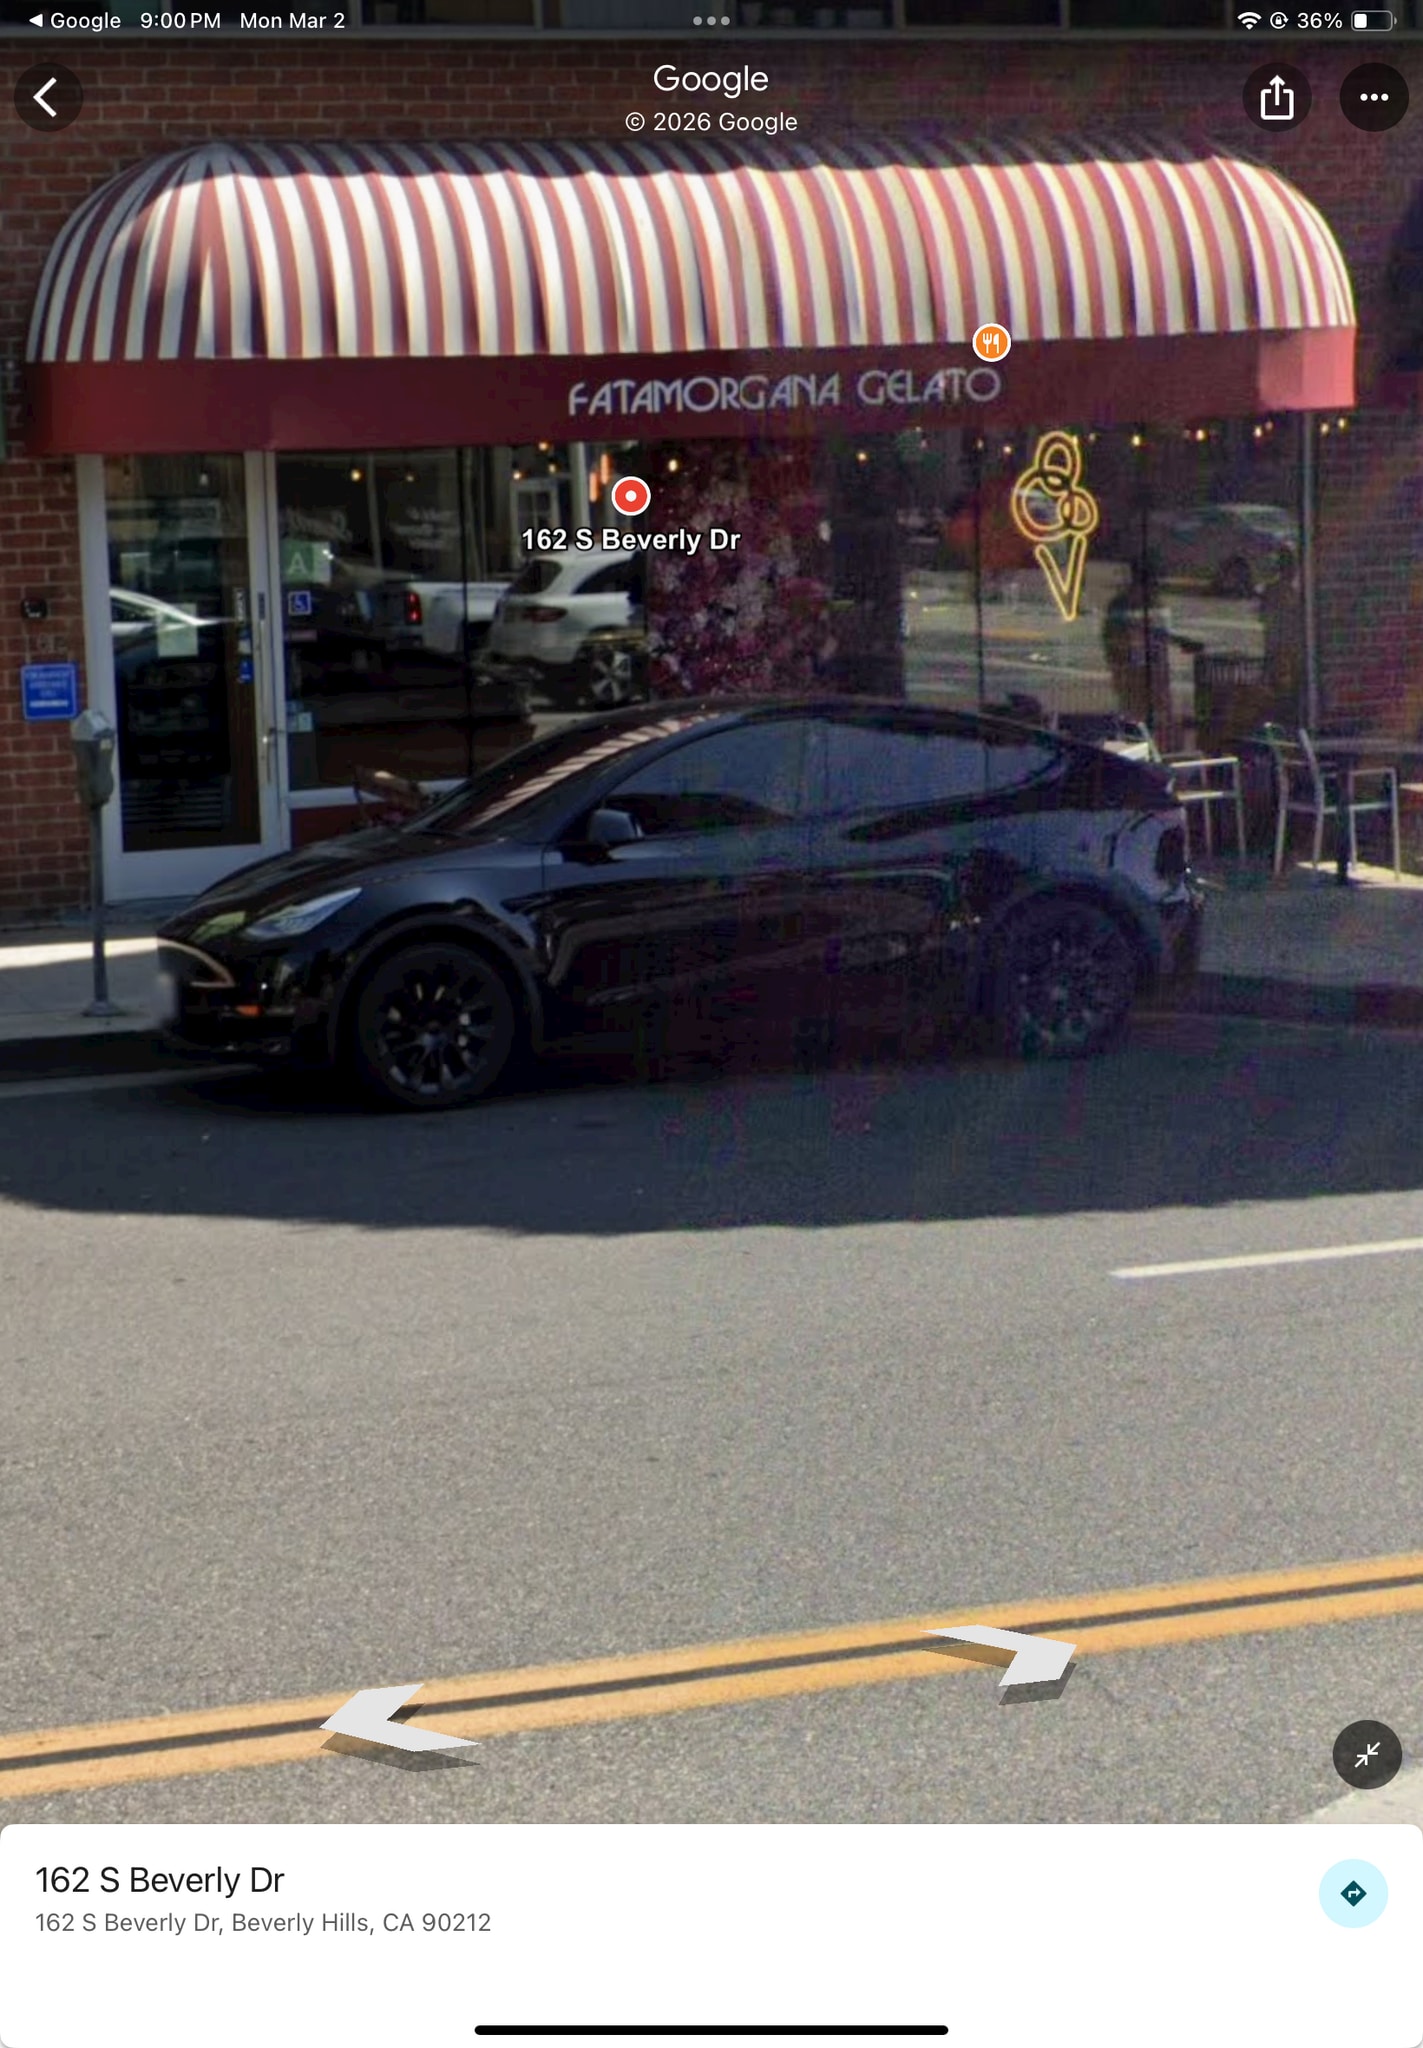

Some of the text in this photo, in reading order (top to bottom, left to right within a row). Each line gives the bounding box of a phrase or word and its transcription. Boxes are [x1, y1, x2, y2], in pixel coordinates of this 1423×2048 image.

[568, 367, 1002, 416] FATAMORGANA GELATO
[288, 551, 308, 576] A
